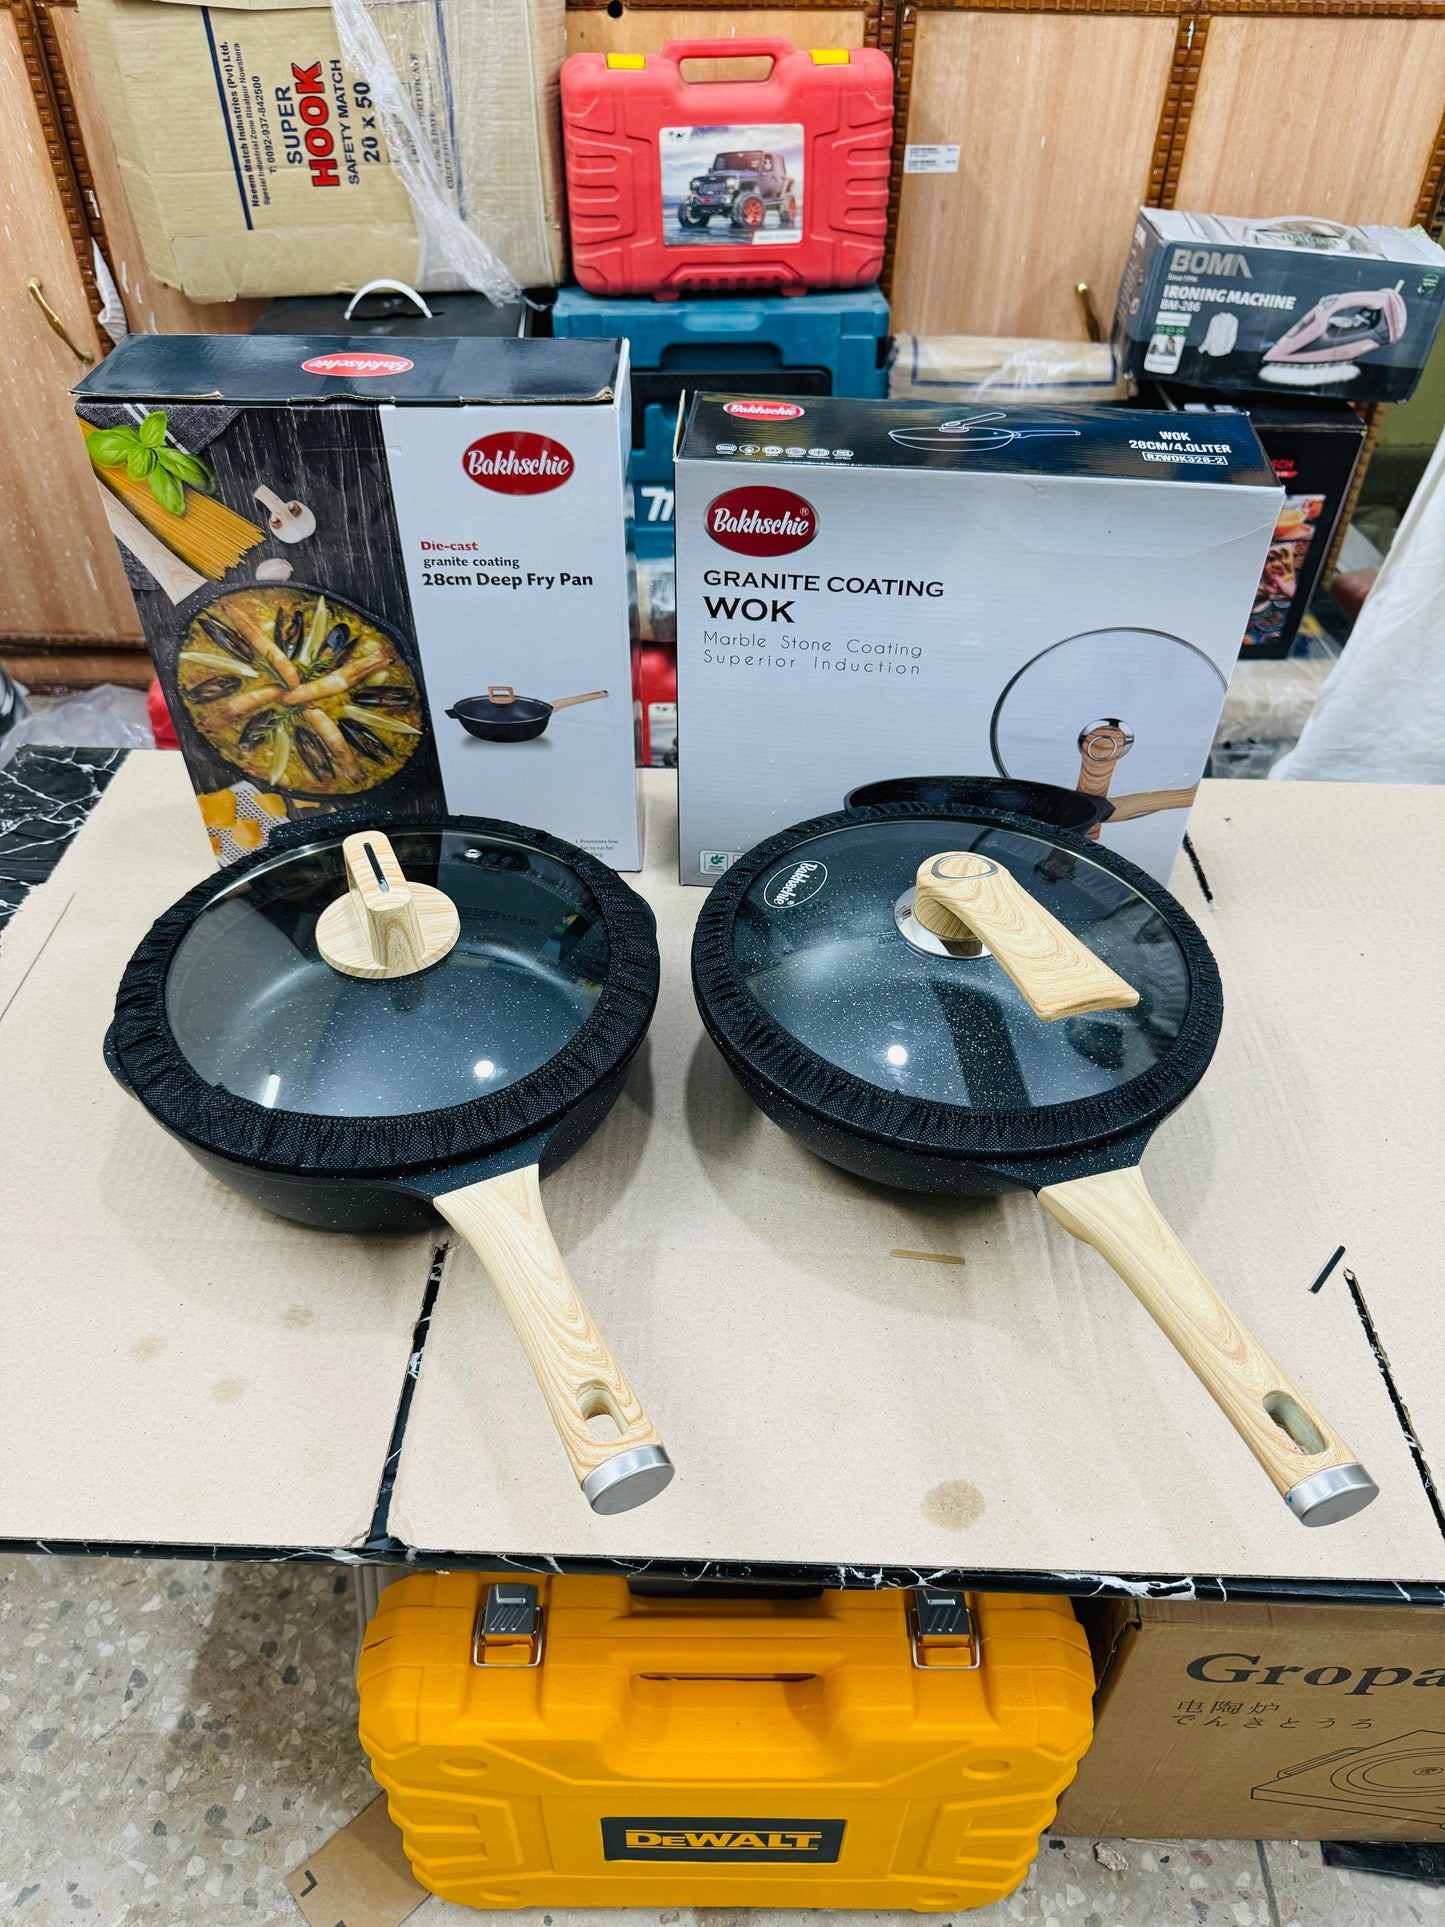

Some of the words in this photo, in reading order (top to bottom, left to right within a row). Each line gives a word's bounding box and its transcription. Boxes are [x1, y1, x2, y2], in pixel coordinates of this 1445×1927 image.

[220, 41, 231, 62] Ltd.
[234, 43, 247, 84] Nowshera
[224, 64, 239, 89] (Pvt)
[330, 59, 349, 118] MATCH
[242, 85, 254, 119] Risalpur
[353, 82, 373, 109] 50
[231, 91, 248, 141] Industries
[249, 119, 259, 140] Zone
[251, 75, 275, 164] 0092-937-842500
[275, 86, 303, 164] SUPER
[291, 60, 341, 187] HOOK
[240, 143, 254, 172] Match
[252, 140, 265, 177] Industrial
[340, 122, 360, 185] SAFETY
[362, 136, 381, 163] 20
[248, 173, 260, 207] Naeem
[259, 178, 272, 206] Special
[1169, 249, 1253, 278] BOMA
[1163, 284, 1227, 303] IRONING
[1226, 289, 1297, 310] MACHINE
[730, 404, 797, 416] Bakhschie
[1159, 430, 1191, 441] WOK
[467, 449, 570, 476] Bakhschie
[713, 507, 810, 536] Bakhschie
[420, 541, 479, 551] Die-cast
[423, 557, 469, 569] granite
[472, 557, 520, 569] coating
[421, 573, 472, 586] 28cm
[476, 572, 523, 590] Deep
[527, 573, 555, 589] Fry
[559, 573, 593, 586] Pan
[703, 569, 820, 592] GRANITE
[826, 576, 945, 597] COATING
[703, 596, 796, 624] WOK
[703, 630, 767, 648] Marble
[780, 635, 832, 652] Stone
[846, 638, 923, 659] Coating
[703, 649, 796, 668] Superior
[814, 656, 921, 675] Induction
[773, 863, 818, 905] Bakhschie
[1186, 1652, 1445, 1696] Gropa
[1177, 1699, 1280, 1715] 电陶炉
